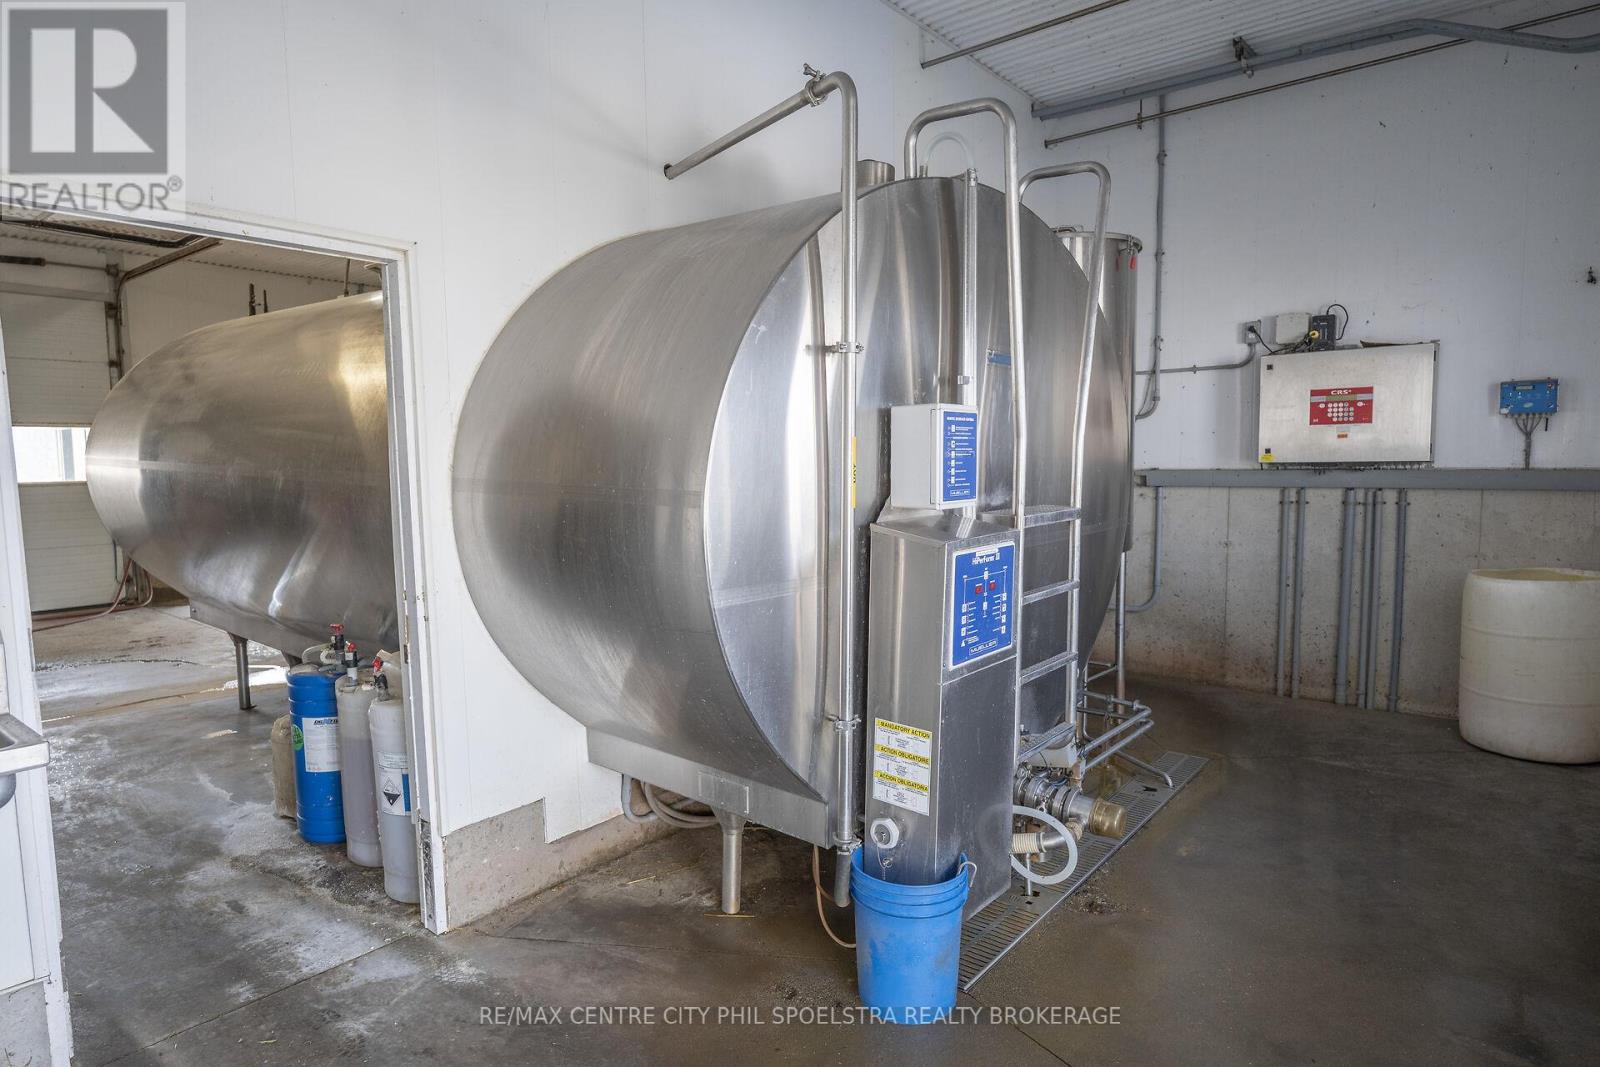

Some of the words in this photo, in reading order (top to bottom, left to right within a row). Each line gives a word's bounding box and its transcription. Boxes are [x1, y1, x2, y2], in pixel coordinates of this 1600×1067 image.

[970, 640, 997, 654] MUELLER
[880, 721, 910, 733] MANDATORY
[911, 729, 930, 738] ACTION
[880, 746, 897, 755] ACTION
[897, 751, 929, 764] OBLIGATOIRE
[896, 777, 929, 791] OBLIGATORIA
